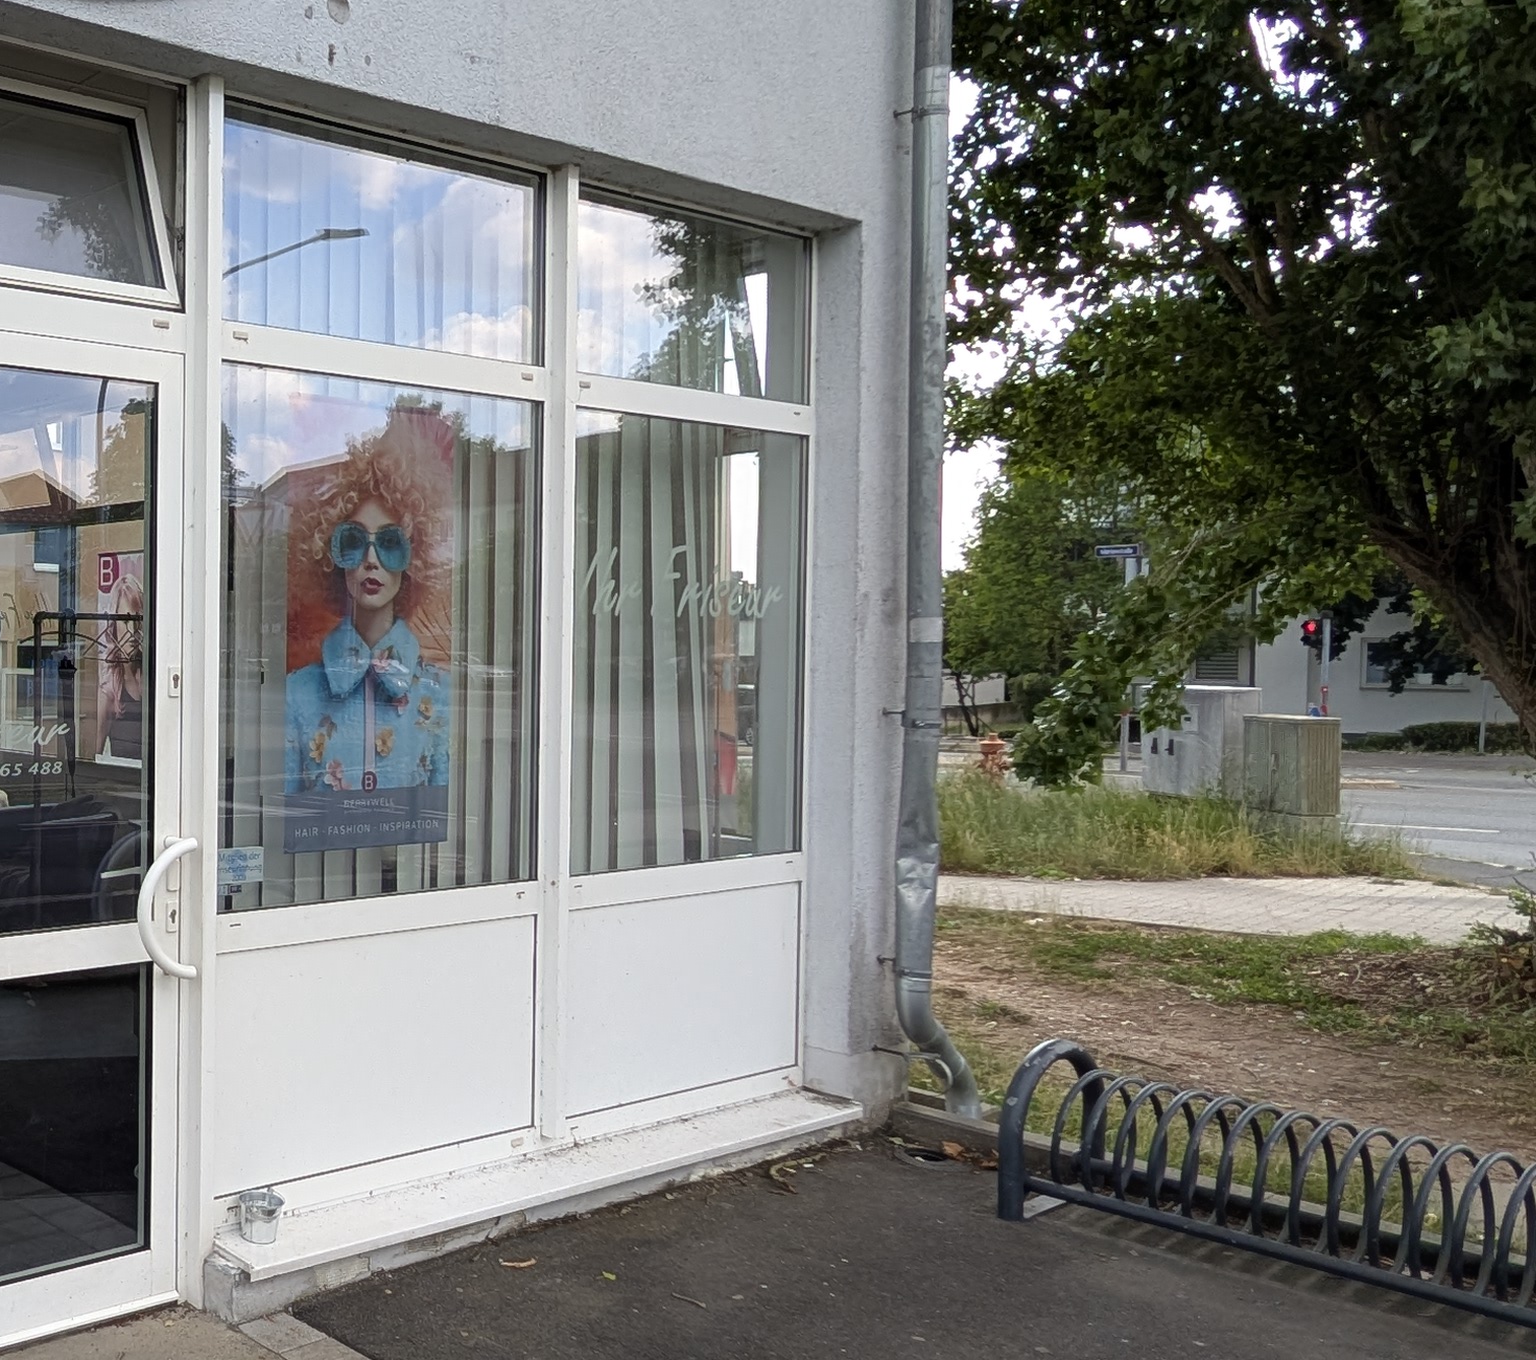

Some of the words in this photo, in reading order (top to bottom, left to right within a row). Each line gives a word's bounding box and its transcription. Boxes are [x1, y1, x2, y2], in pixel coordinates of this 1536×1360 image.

[651, 545, 784, 618] Friseur
[28, 761, 63, 775] 488
[295, 827, 319, 837] HAIR
[327, 823, 371, 835] FASHION
[379, 818, 440, 832] INSPIRATION
